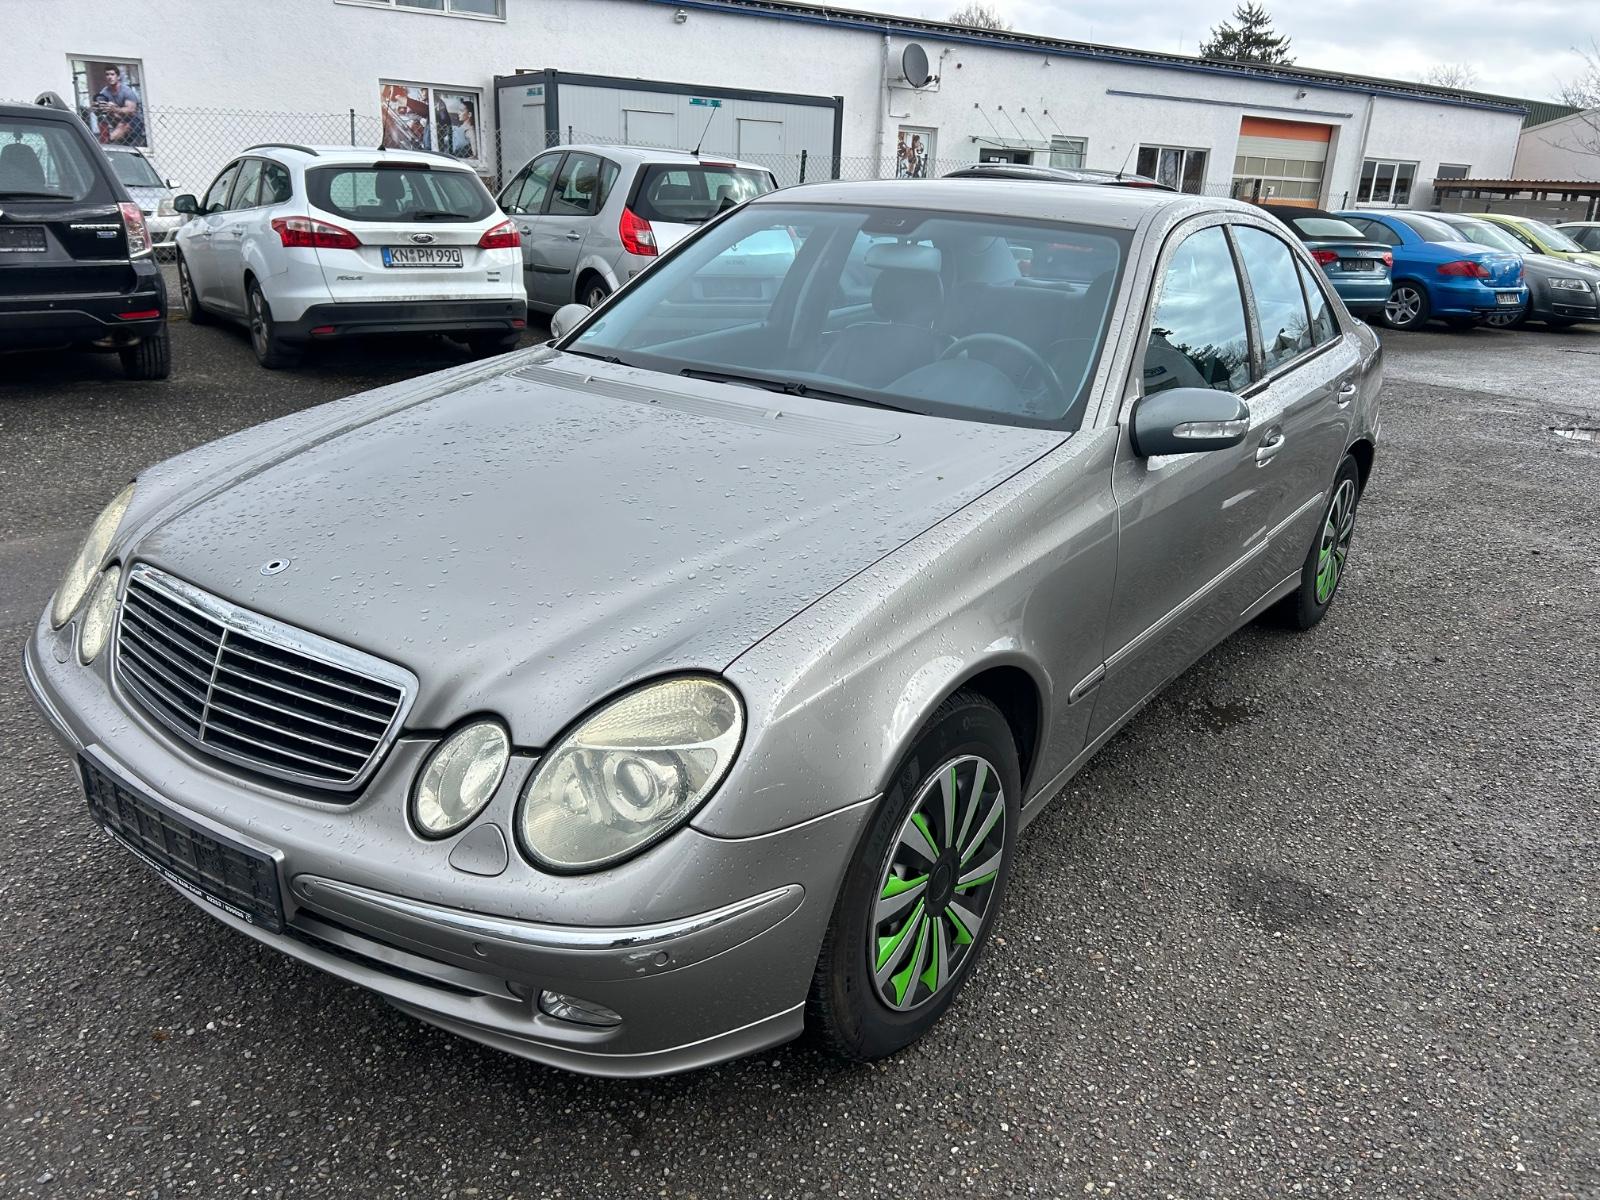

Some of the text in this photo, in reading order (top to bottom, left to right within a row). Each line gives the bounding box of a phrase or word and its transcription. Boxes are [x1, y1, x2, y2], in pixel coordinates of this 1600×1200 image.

[390, 249, 460, 263] KN PM 990
